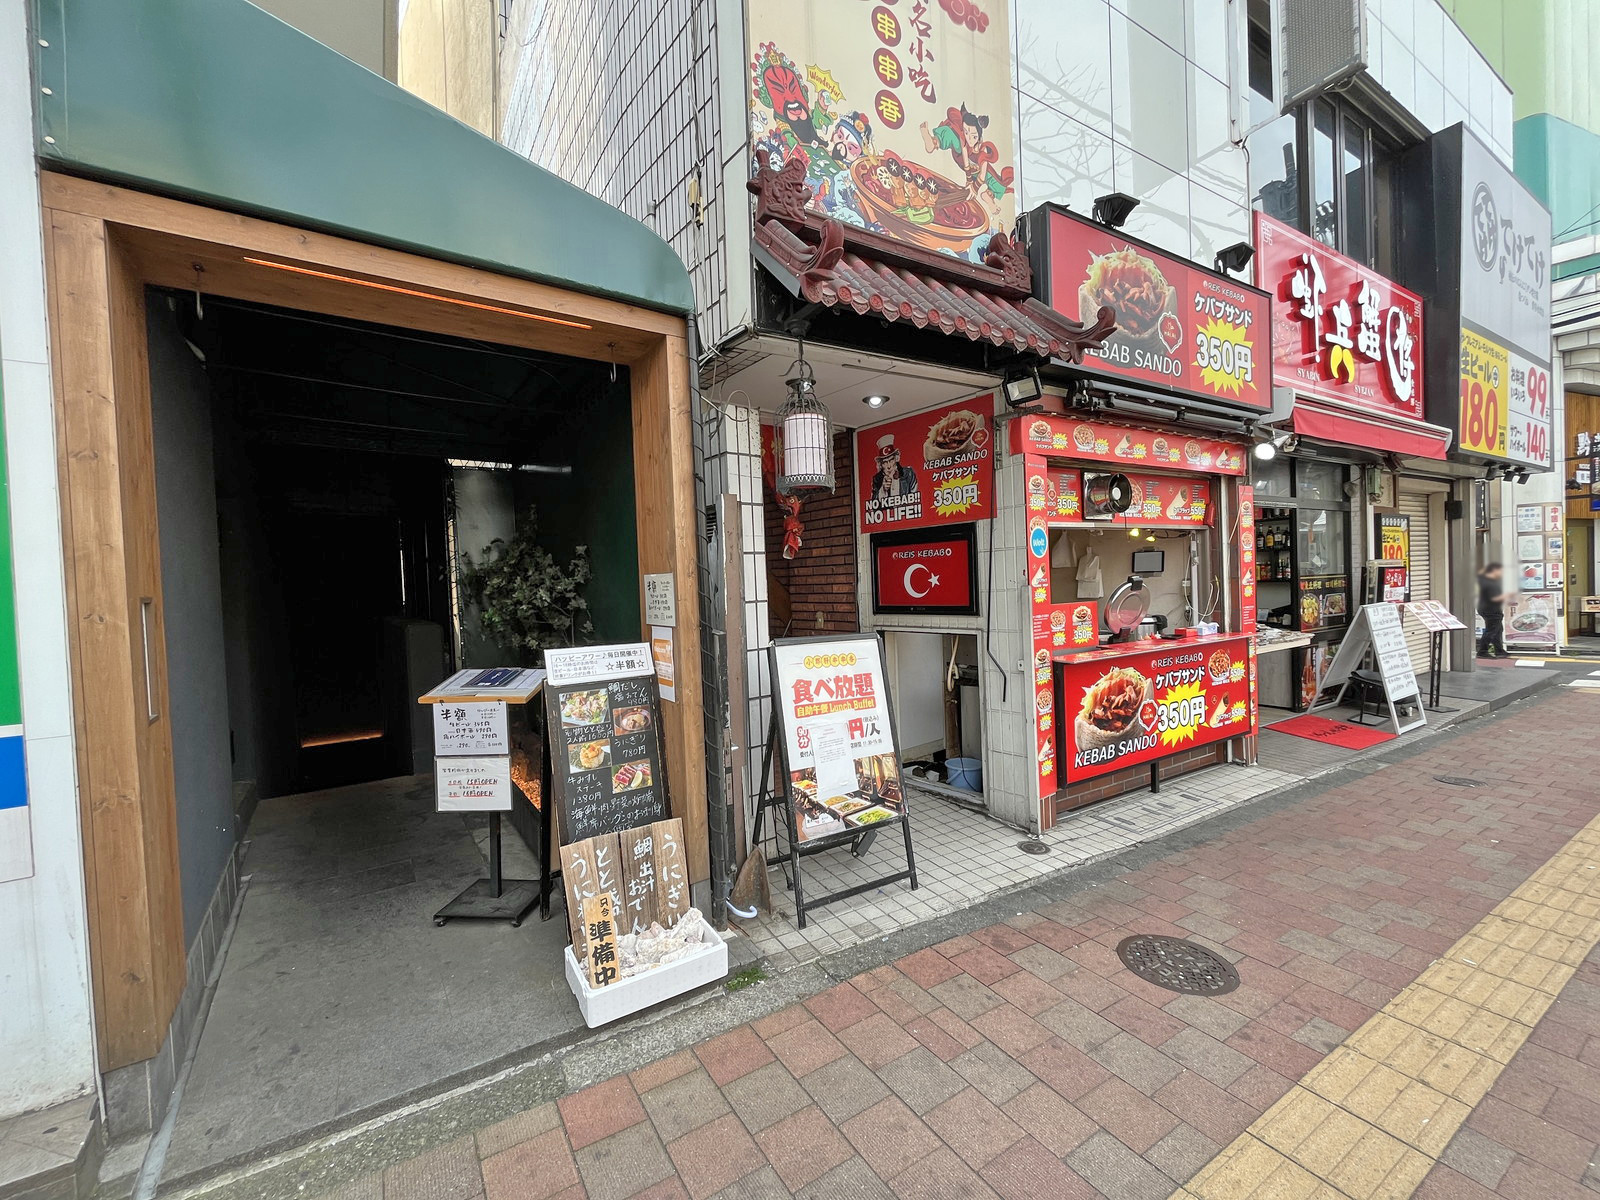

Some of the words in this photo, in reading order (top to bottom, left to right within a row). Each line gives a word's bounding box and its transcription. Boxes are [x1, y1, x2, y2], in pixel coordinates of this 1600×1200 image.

[907, 0, 936, 104] 名小吃
[876, 13, 901, 123] 串串香
[809, 70, 841, 98] Wonderful
[1195, 291, 1252, 328] ケバブサンド
[1134, 348, 1182, 377] SANDO
[1196, 331, 1252, 383] 350円
[1527, 366, 1547, 418] 99
[1460, 378, 1498, 451] 180
[1526, 422, 1546, 462] 140
[923, 455, 953, 471] KEBAB
[954, 448, 989, 464] SANDO
[932, 464, 979, 482] ケバブサンド
[865, 499, 880, 511] NO
[881, 491, 921, 508] KEBAB!!
[933, 483, 979, 508] 350円
[1057, 498, 1078, 510] 350円
[865, 511, 884, 525] NO
[886, 503, 922, 522] LIFE!!
[899, 550, 916, 559] REIS
[1073, 629, 1091, 640] 350円
[1157, 657, 1173, 668] REIS
[791, 672, 875, 705] 食べ放題
[1156, 665, 1206, 690] ケバブサンド
[440, 708, 468, 722] 半額
[829, 702, 852, 713] Lunch
[1157, 694, 1206, 733] 350円
[622, 745, 646, 758] 780円
[1074, 743, 1116, 769] KEBAB
[1118, 732, 1158, 756] SANDO
[571, 792, 602, 806] 1380円
[576, 782, 603, 793] ステーキ
[599, 897, 610, 918] 只今
[589, 919, 617, 987] 準備中
